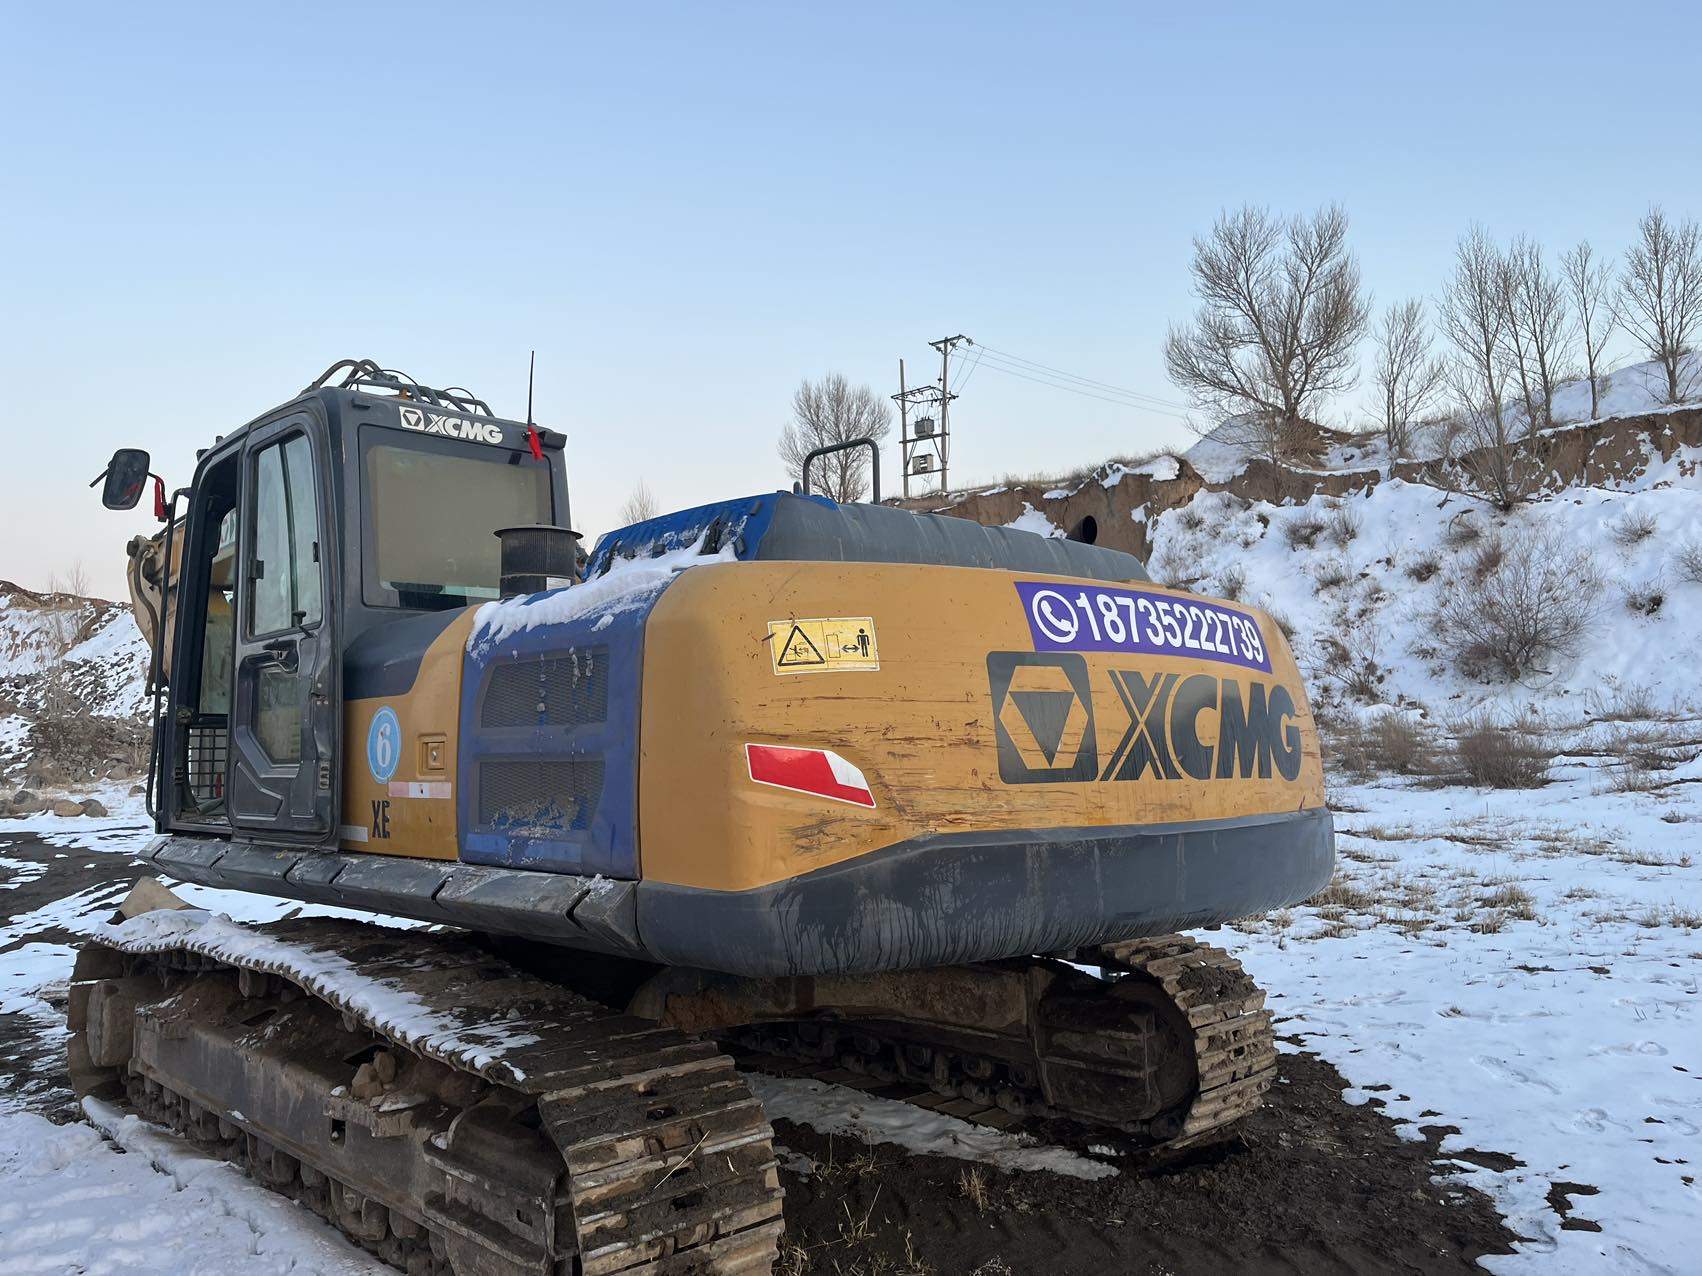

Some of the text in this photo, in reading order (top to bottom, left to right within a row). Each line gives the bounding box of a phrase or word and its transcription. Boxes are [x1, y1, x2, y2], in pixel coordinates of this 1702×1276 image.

[425, 413, 503, 444] XCMG
[1076, 592, 1265, 663] 18735222739
[376, 723, 392, 767] 6
[1100, 670, 1302, 782] XCMG
